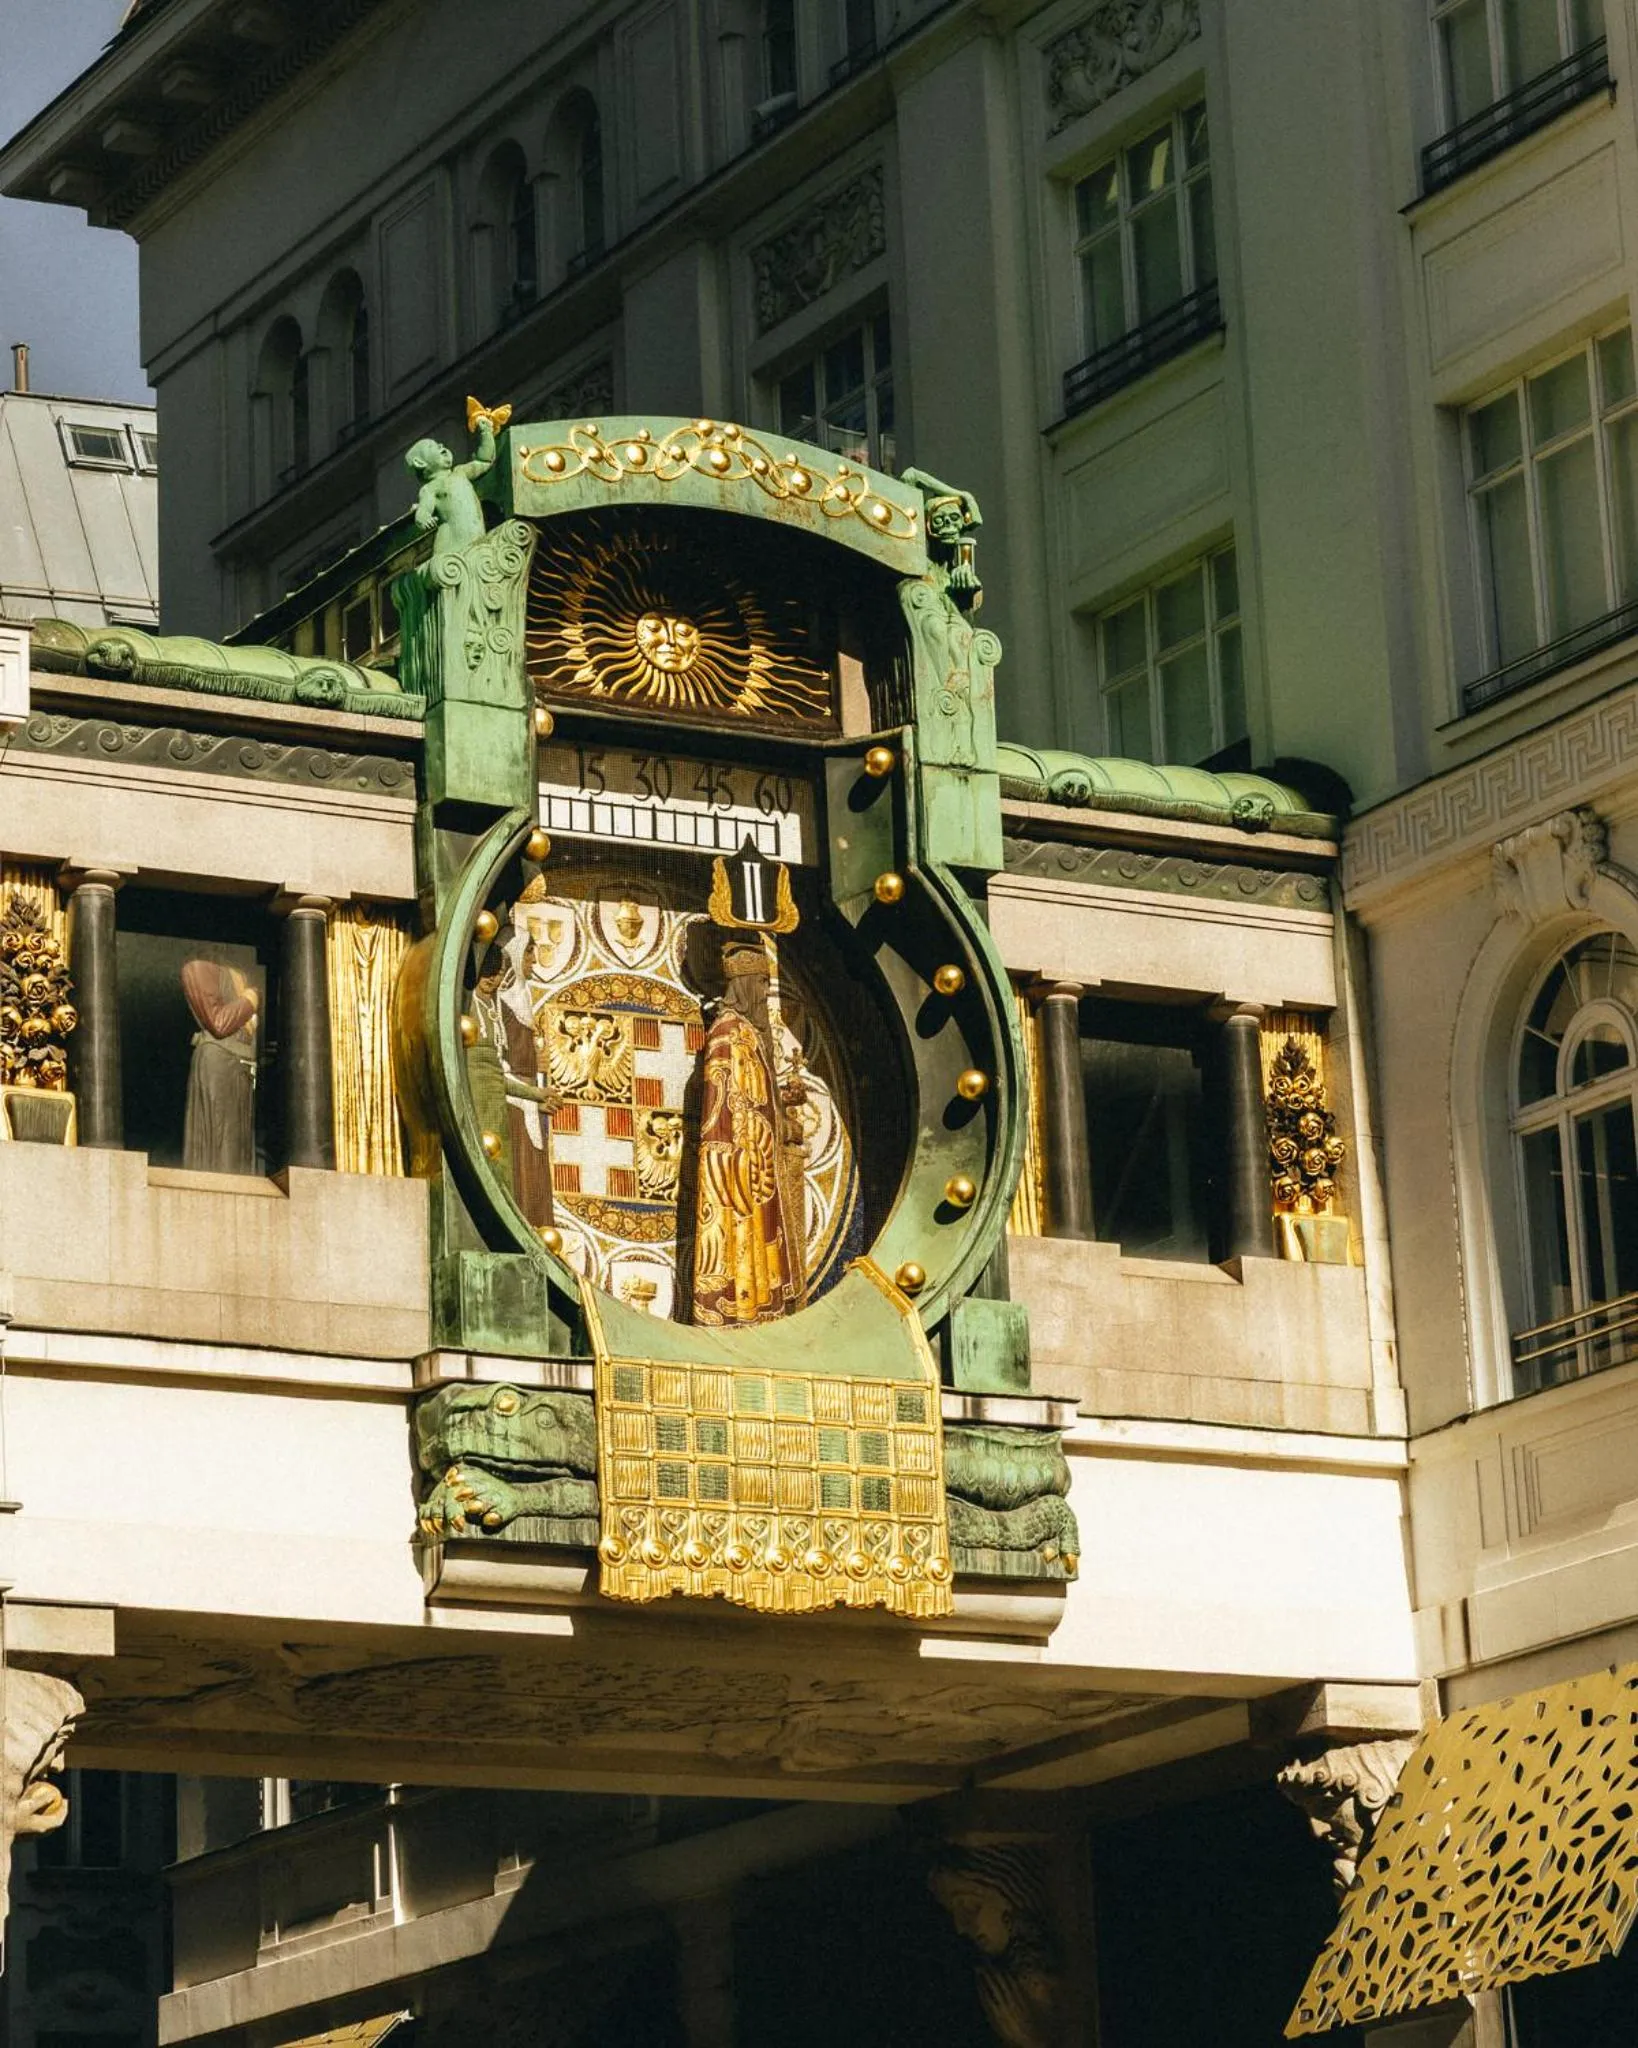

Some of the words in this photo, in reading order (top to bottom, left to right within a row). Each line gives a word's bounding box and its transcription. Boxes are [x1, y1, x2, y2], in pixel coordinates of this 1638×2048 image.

[578, 747, 605, 796] 15
[631, 756, 672, 804] 30
[692, 763, 735, 811] 45
[754, 774, 793, 819] 60
[742, 861, 765, 922] II
